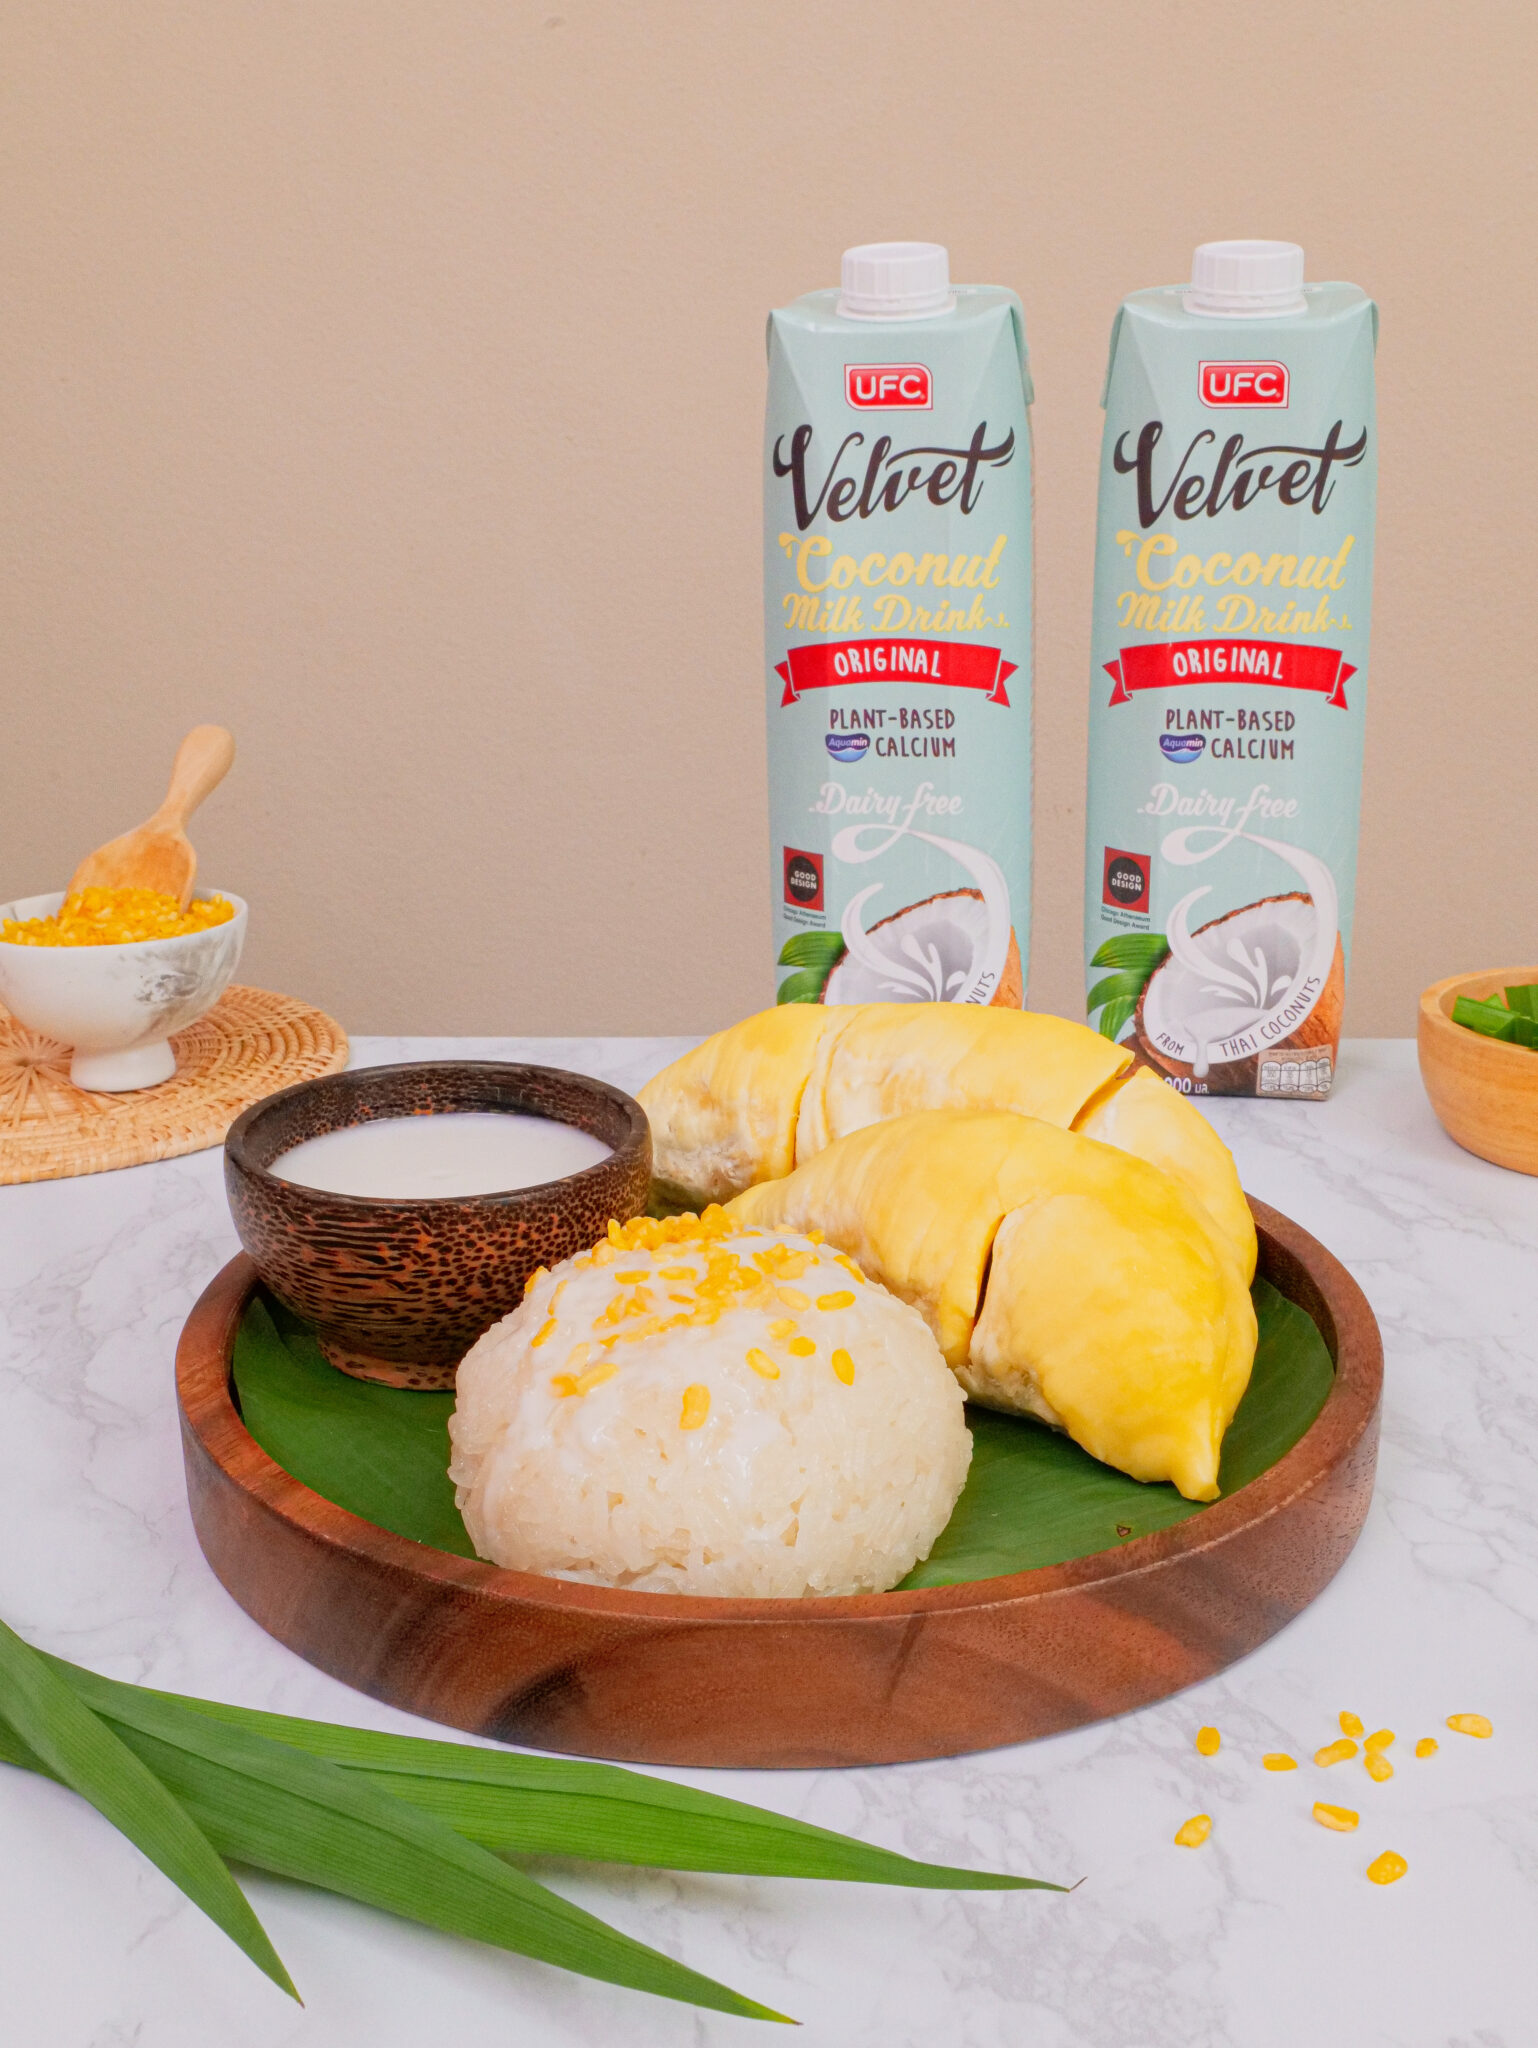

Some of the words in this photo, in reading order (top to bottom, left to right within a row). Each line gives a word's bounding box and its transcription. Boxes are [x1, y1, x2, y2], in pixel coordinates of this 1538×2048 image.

[855, 374, 922, 400] UFC
[1209, 372, 1278, 398] UFC
[772, 420, 1015, 531] Velvet
[1113, 419, 1368, 529] Velvet
[778, 532, 1008, 593] Coconut
[1115, 529, 1356, 591] Coconut
[782, 592, 865, 633] Milk
[870, 592, 1010, 633] Drink
[1116, 591, 1207, 633] Milk
[1213, 593, 1352, 634] Drink
[834, 646, 942, 678] ORIGINAL
[1172, 647, 1283, 679] ORIGINAL
[829, 707, 956, 730] PLANT-BASED
[1165, 708, 1296, 732] PLANT-BASED
[828, 737, 868, 748] Aquamin
[875, 736, 956, 758] CALCIUM
[1162, 737, 1204, 749] Aquamin
[1210, 737, 1295, 760] CALCIUM
[808, 782, 903, 824] Dairy
[902, 782, 964, 832] free
[1137, 782, 1236, 826] Dairy
[1235, 783, 1300, 833] free
[790, 877, 817, 890] DESIGN
[794, 870, 817, 881] GOOD
[1111, 878, 1142, 891] DESIGN
[1116, 871, 1142, 883] GOOD
[1155, 1032, 1185, 1056] FROM
[1220, 1034, 1258, 1057] THAI
[1260, 976, 1321, 1040] COCONUTS
